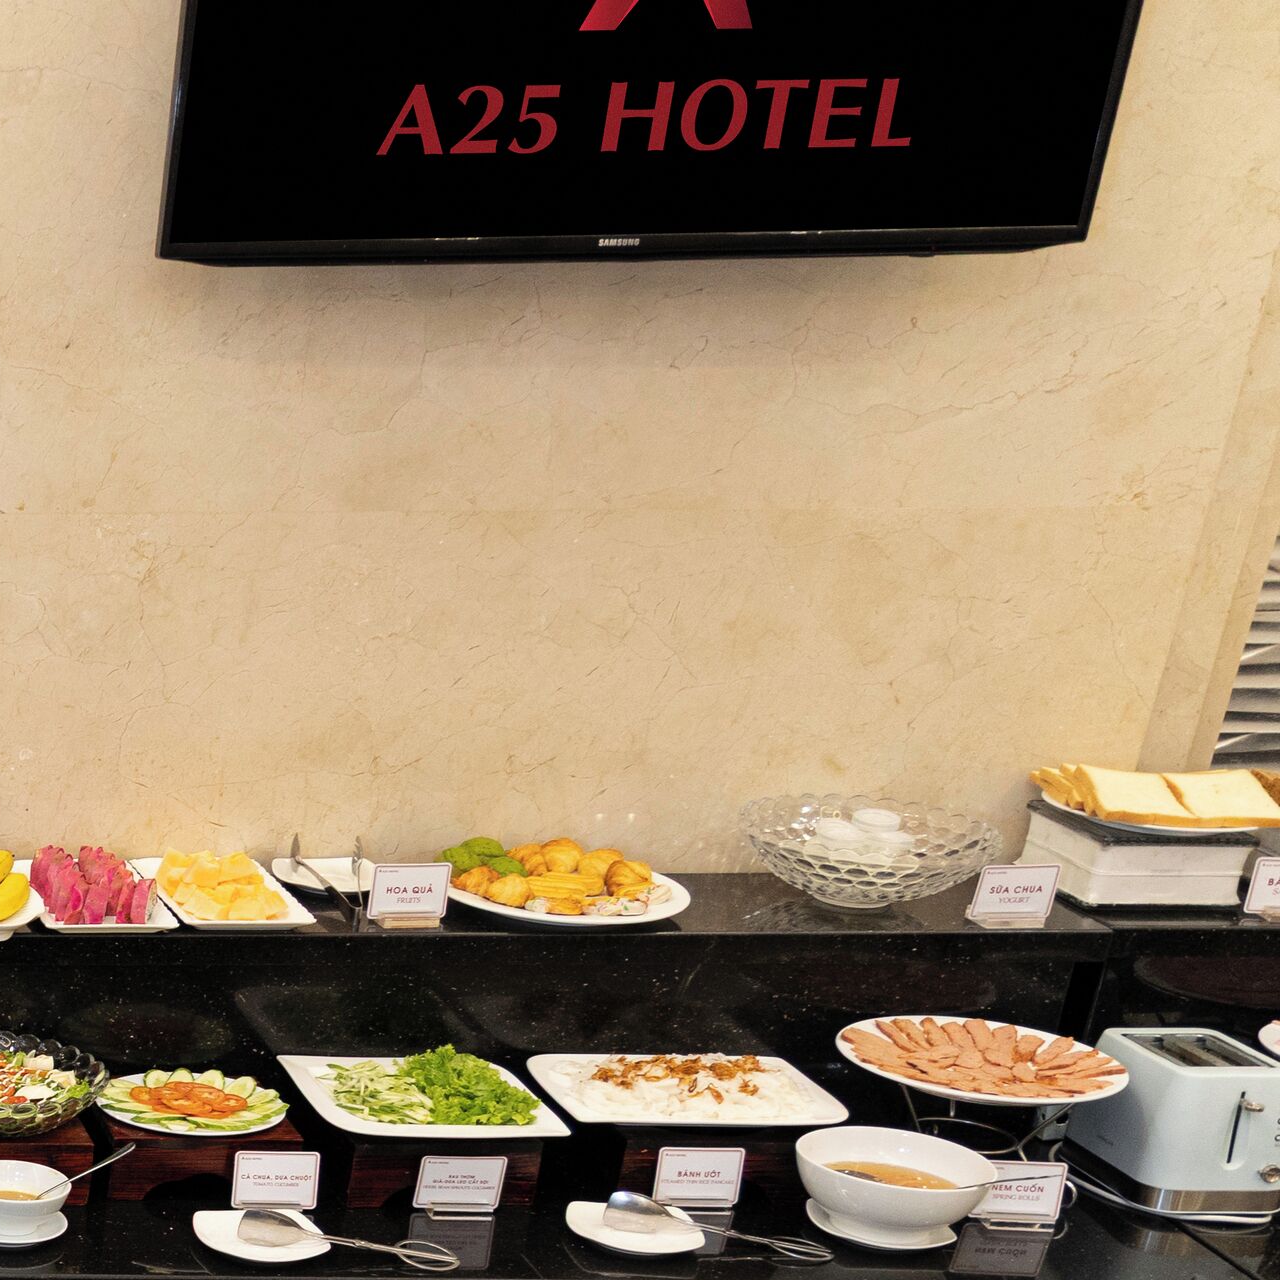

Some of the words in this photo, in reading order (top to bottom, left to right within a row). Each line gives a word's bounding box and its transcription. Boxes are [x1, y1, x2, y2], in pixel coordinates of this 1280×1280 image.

[376, 83, 561, 156] A25
[600, 78, 911, 152] HOTEL
[598, 238, 640, 247] SAMSUNG
[386, 886, 408, 894] HOA
[412, 883, 433, 894] QUẢ
[989, 884, 1009, 894] SỮA
[1013, 885, 1043, 894] CHUA
[677, 1169, 700, 1178] BÁNH
[1015, 1183, 1044, 1193] CUỐN
